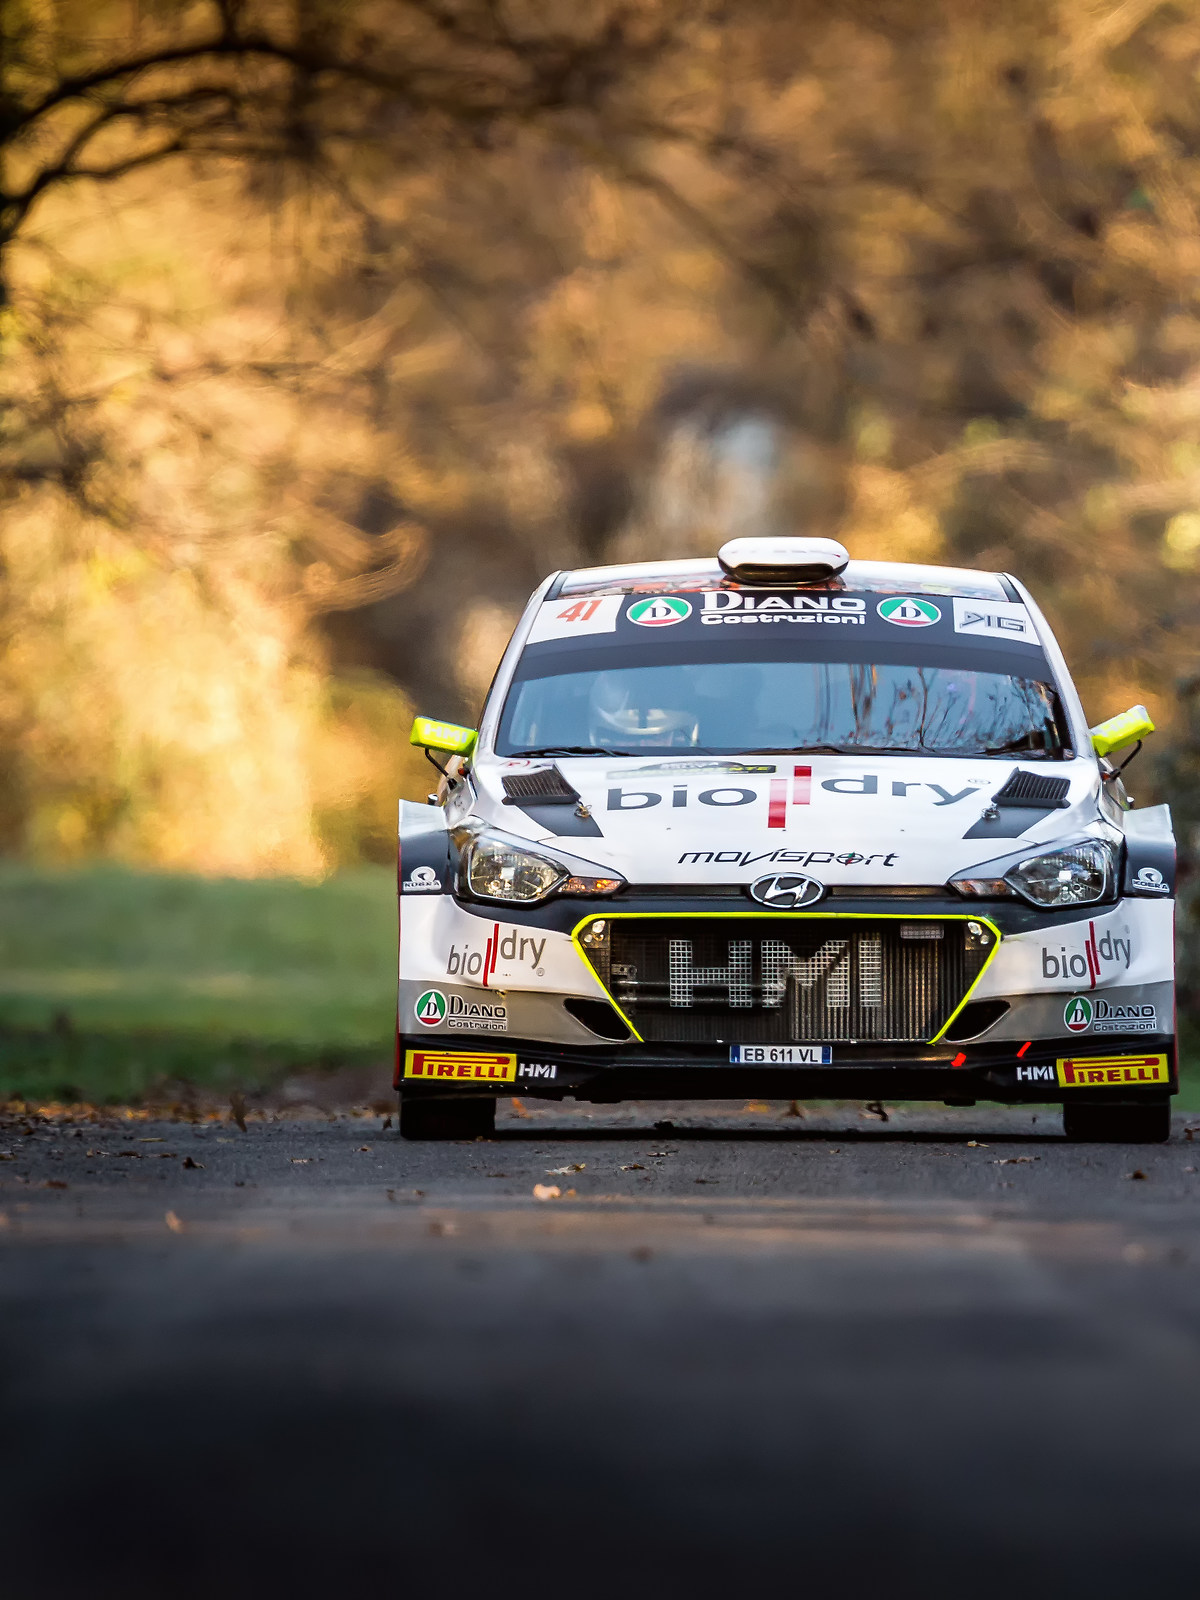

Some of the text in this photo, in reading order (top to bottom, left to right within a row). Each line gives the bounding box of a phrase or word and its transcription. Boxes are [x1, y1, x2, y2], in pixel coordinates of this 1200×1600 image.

[557, 599, 603, 622] 41
[701, 591, 866, 611] DIANO
[701, 613, 866, 625] Costruzioni
[424, 723, 467, 744] HMI
[669, 940, 882, 1008] HMI
[449, 995, 507, 1018] DIANO
[1095, 1000, 1155, 1019] DIANO
[448, 1019, 507, 1031] Costruzioni
[1094, 1021, 1157, 1032] Costruzioni
[744, 1048, 818, 1062] EB 611 VL
[412, 1053, 510, 1079] PIRELLI
[518, 1063, 558, 1079] HMI
[1016, 1065, 1055, 1081] HMI
[1063, 1058, 1160, 1084] PIRELLI
